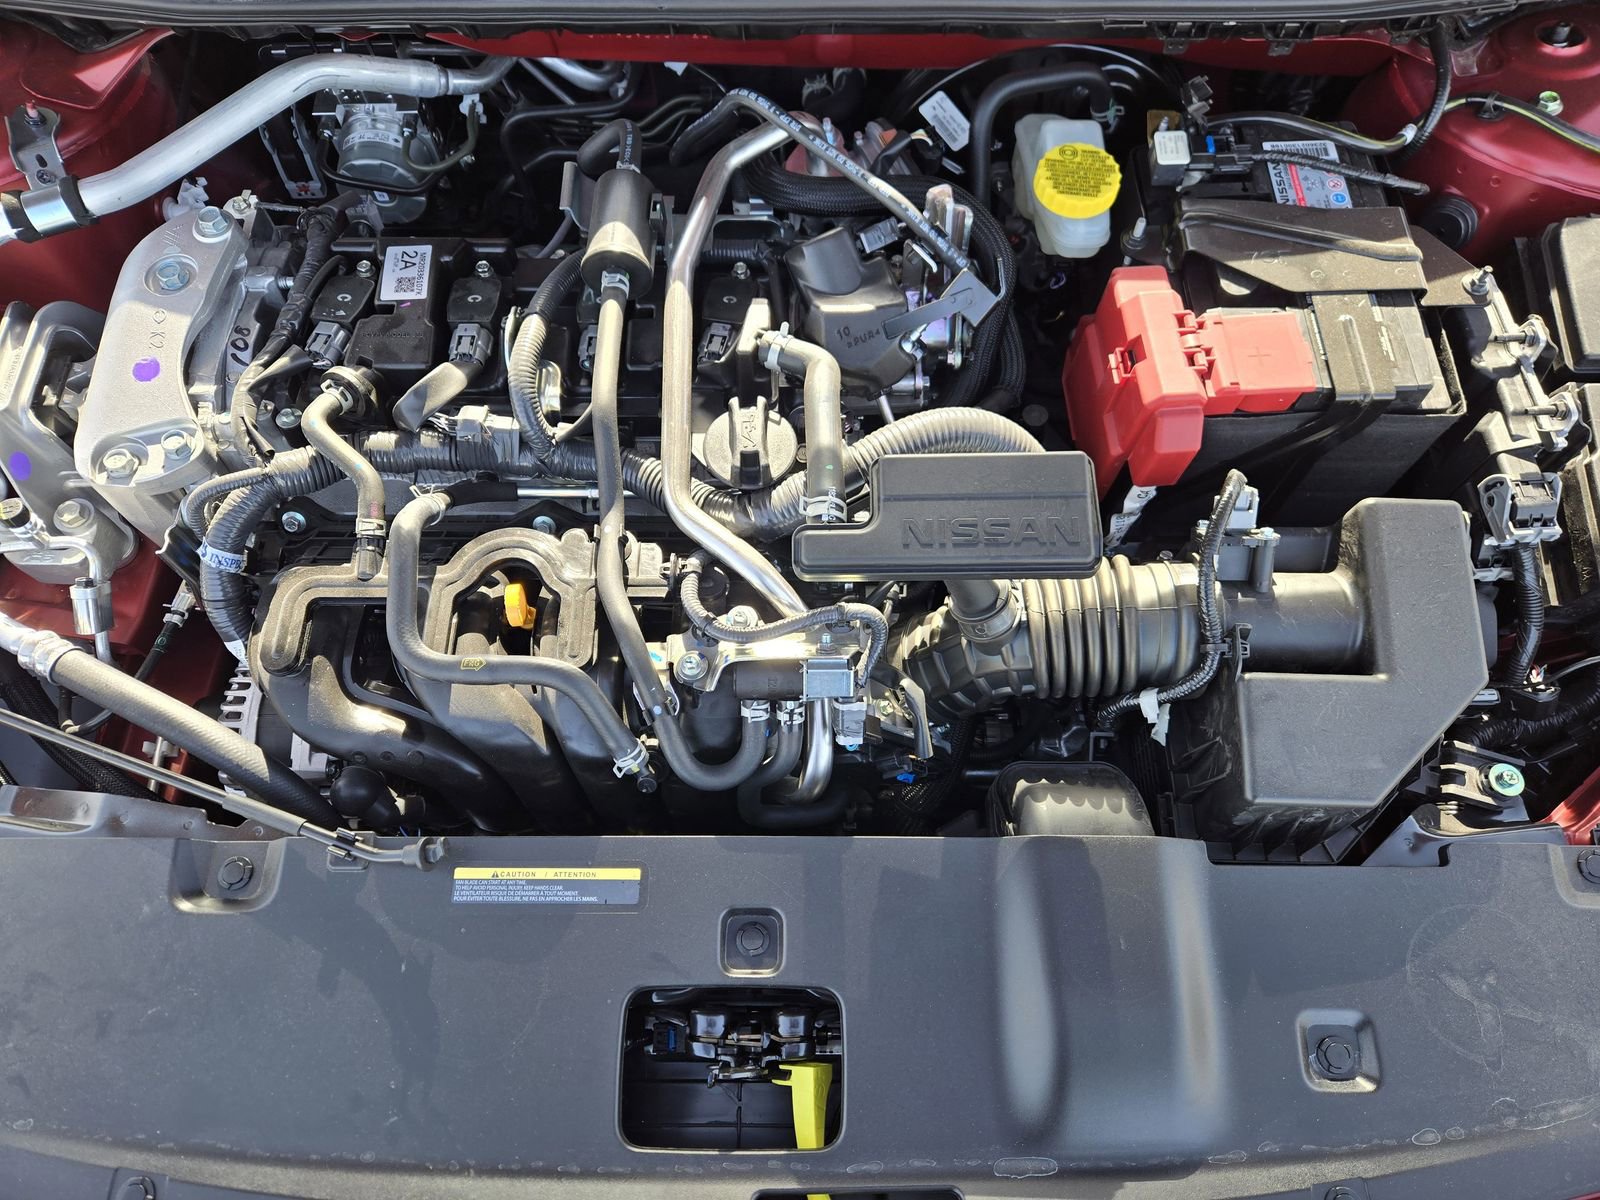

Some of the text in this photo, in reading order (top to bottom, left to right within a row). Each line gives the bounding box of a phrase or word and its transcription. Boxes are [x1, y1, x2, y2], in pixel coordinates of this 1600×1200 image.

[1272, 160, 1290, 204] NISSAN
[400, 250, 418, 271] 2A
[336, 293, 352, 302] C
[467, 294, 482, 302] C
[722, 296, 738, 304] C
[230, 325, 251, 366] 108
[902, 516, 1081, 549] NISSAN
